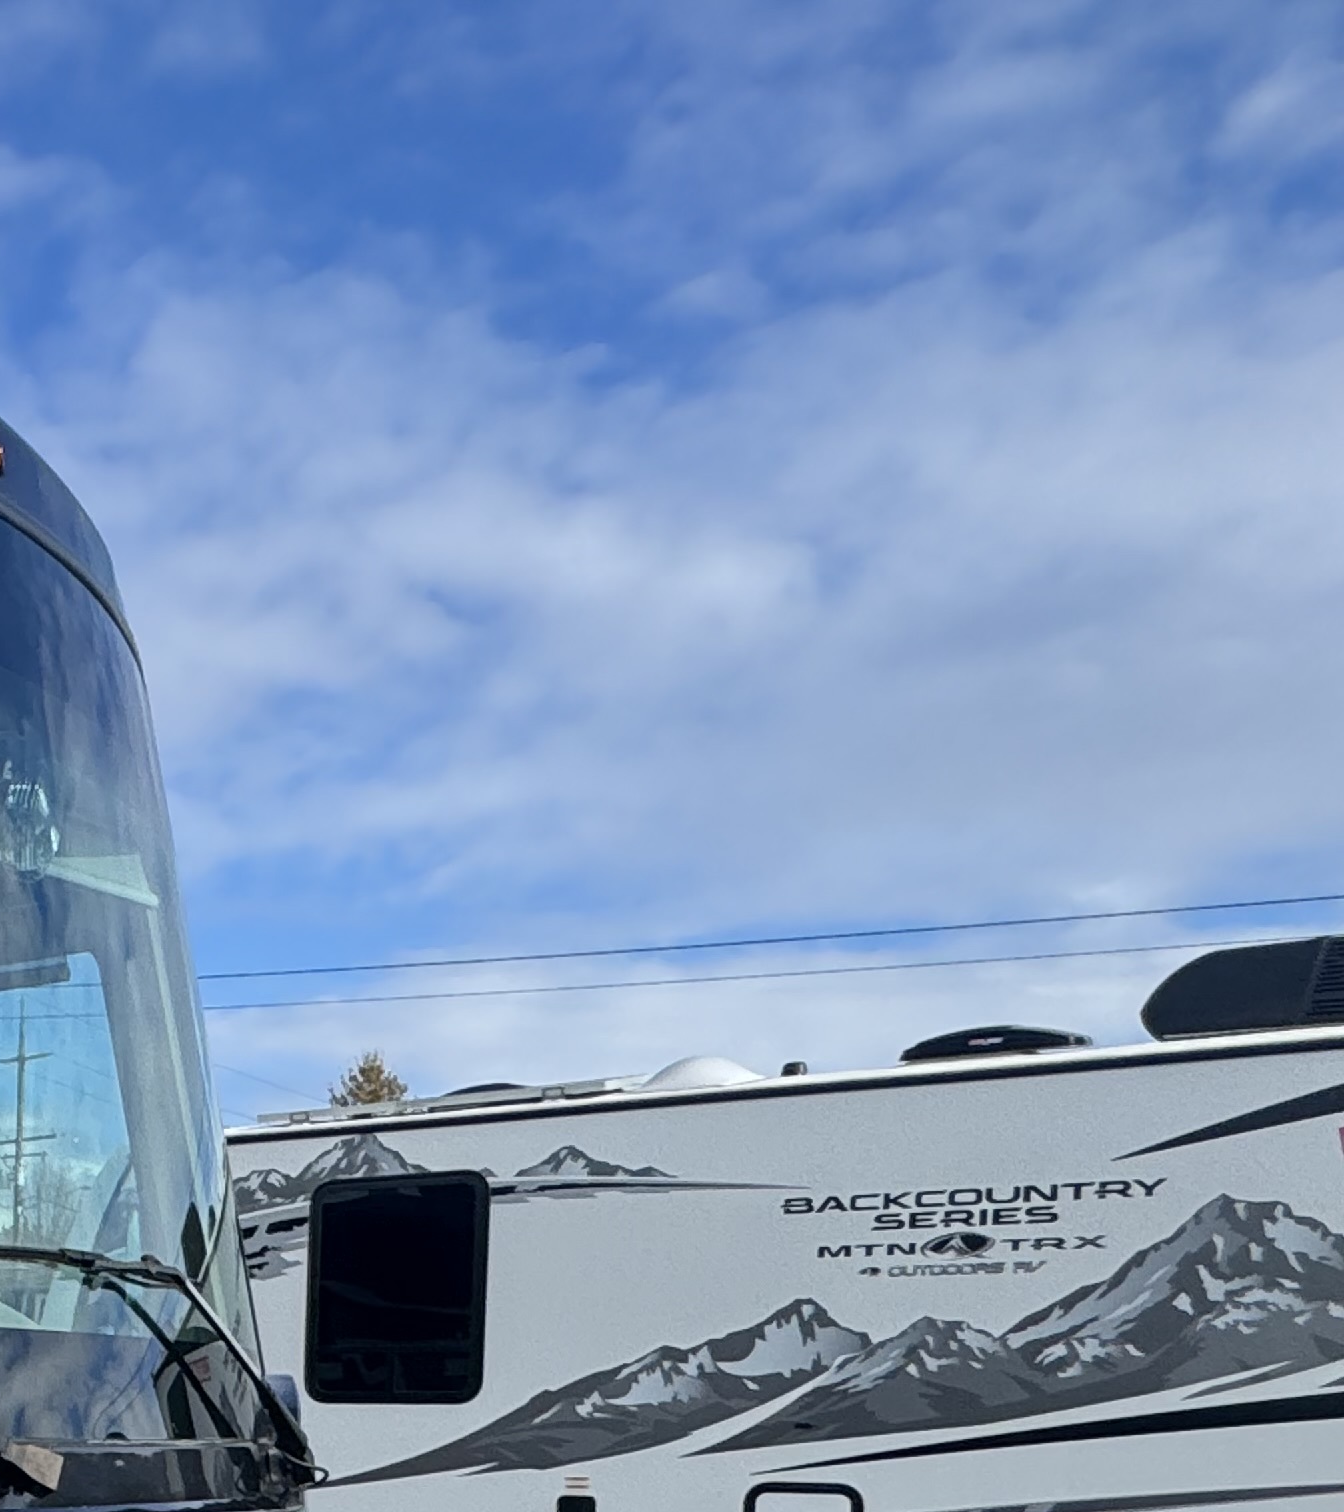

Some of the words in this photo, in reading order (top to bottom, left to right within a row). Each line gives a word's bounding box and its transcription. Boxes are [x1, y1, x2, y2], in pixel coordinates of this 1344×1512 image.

[780, 1178, 1168, 1216] BACKCOUNTRY
[871, 1206, 1059, 1231] SERIES
[816, 1242, 918, 1259] MTN
[1000, 1235, 1108, 1251] TRX
[887, 1262, 1006, 1277] OUTDOORS
